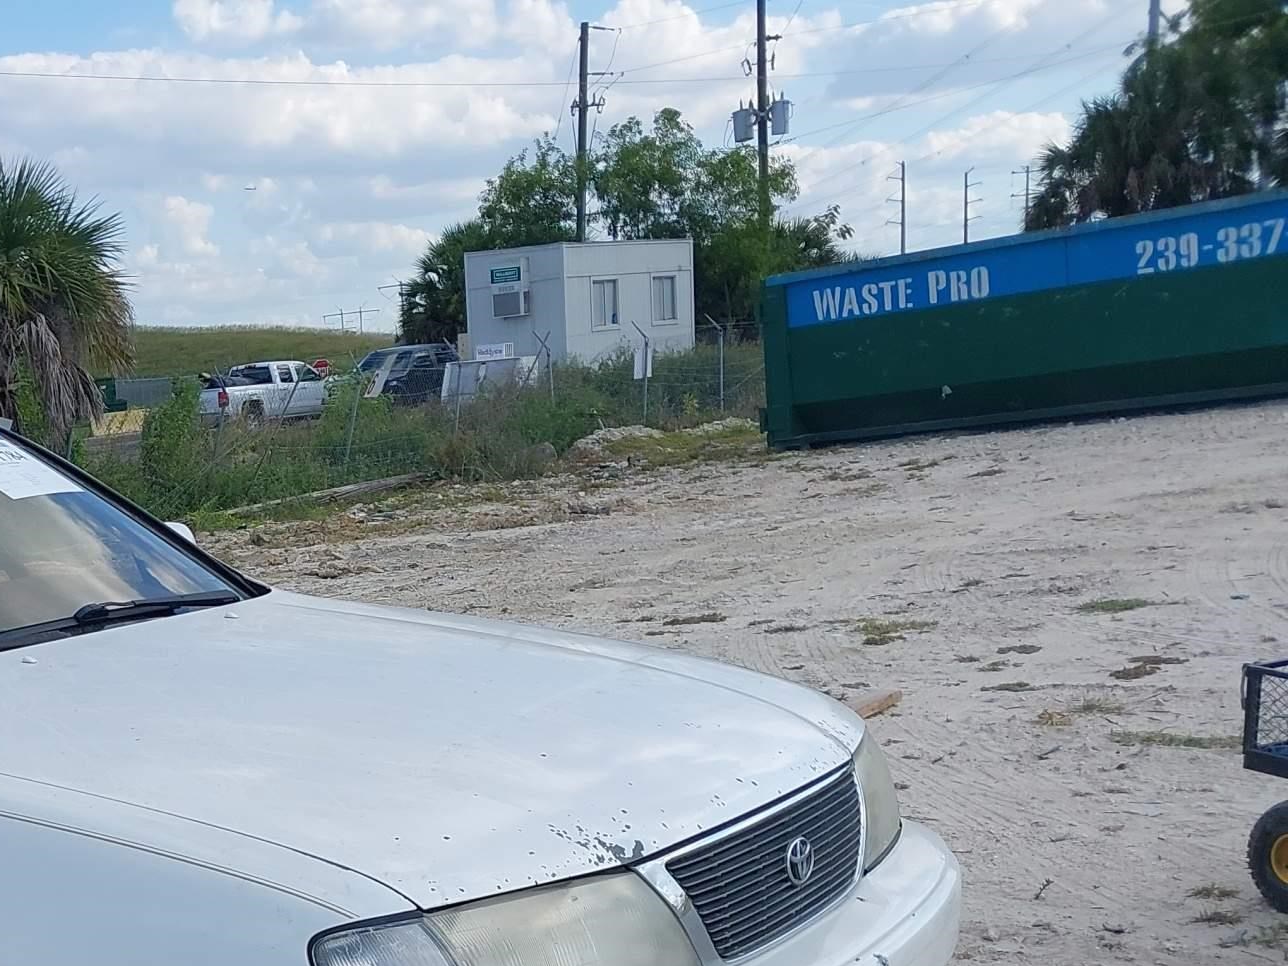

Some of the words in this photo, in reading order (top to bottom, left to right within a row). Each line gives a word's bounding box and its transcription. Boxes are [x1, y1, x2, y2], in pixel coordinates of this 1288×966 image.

[1136, 218, 1288, 275] 239-337
[812, 278, 913, 321] WASTE
[927, 266, 990, 305] PRO
